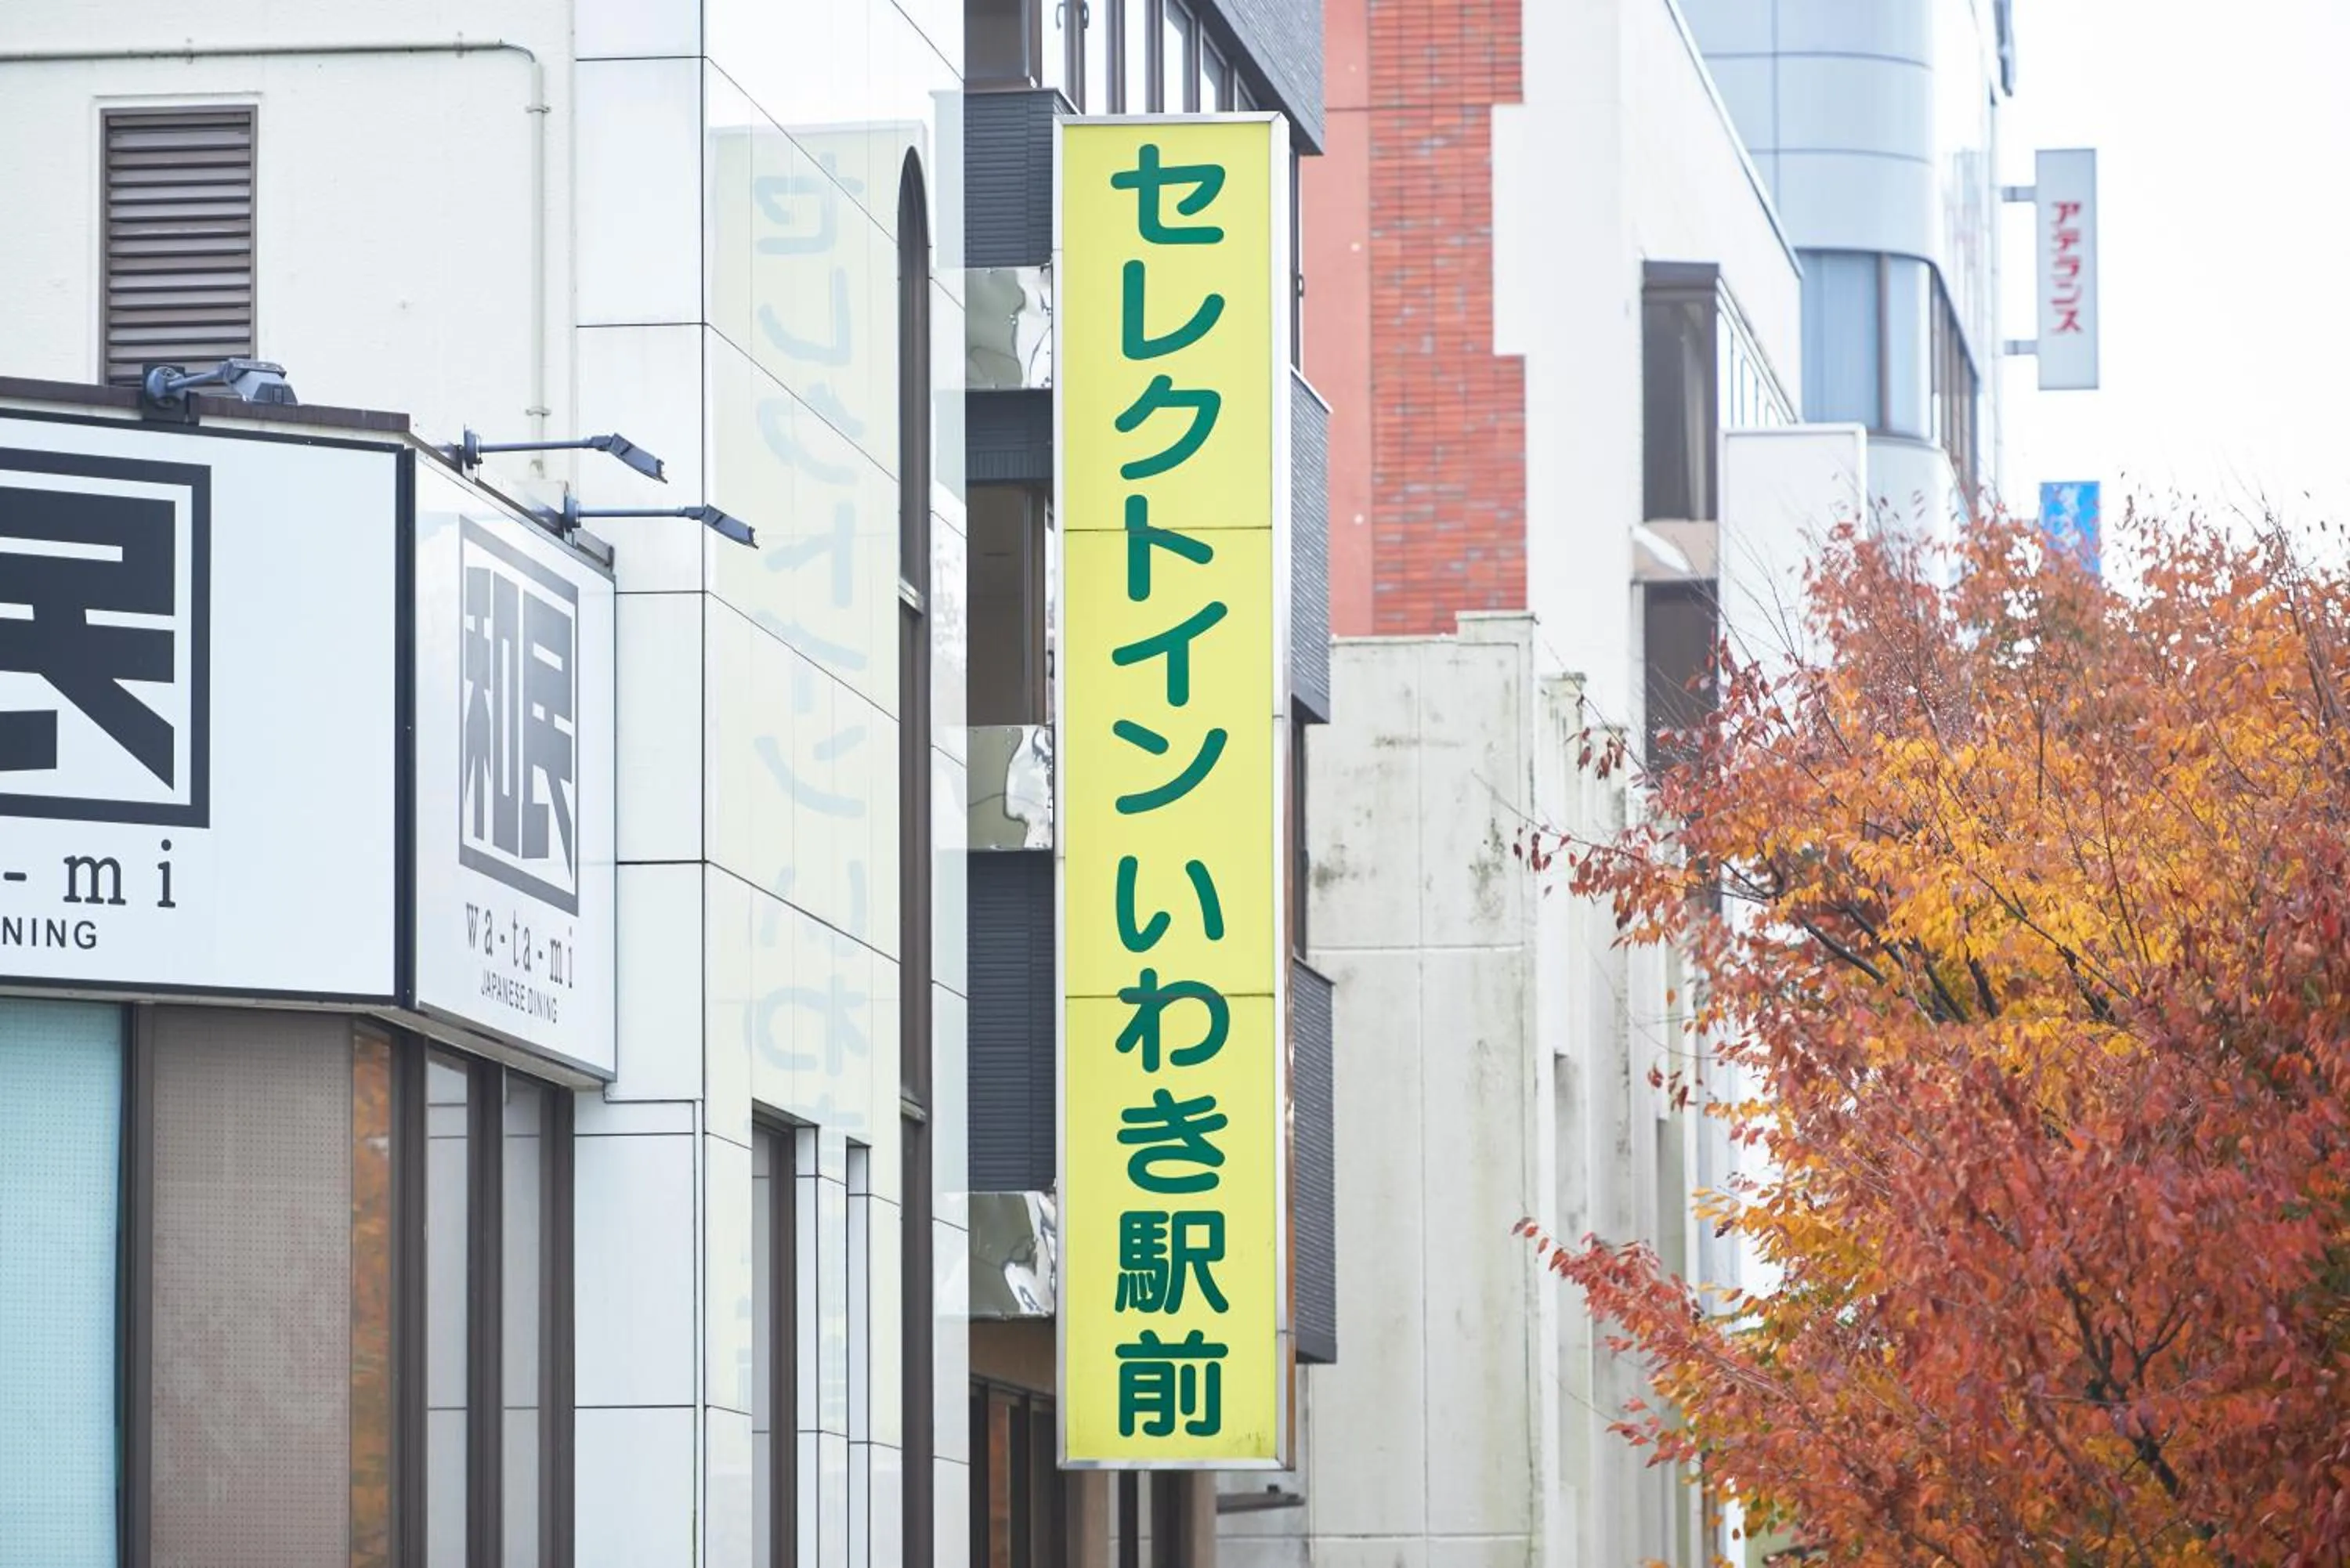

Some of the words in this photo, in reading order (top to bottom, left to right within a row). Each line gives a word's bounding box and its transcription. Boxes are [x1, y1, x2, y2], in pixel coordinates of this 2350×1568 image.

[481, 970, 525, 1011] JAPANESE
[528, 988, 557, 1024] DINING
[1111, 144, 1229, 1438] セレクトインいわき駅前
